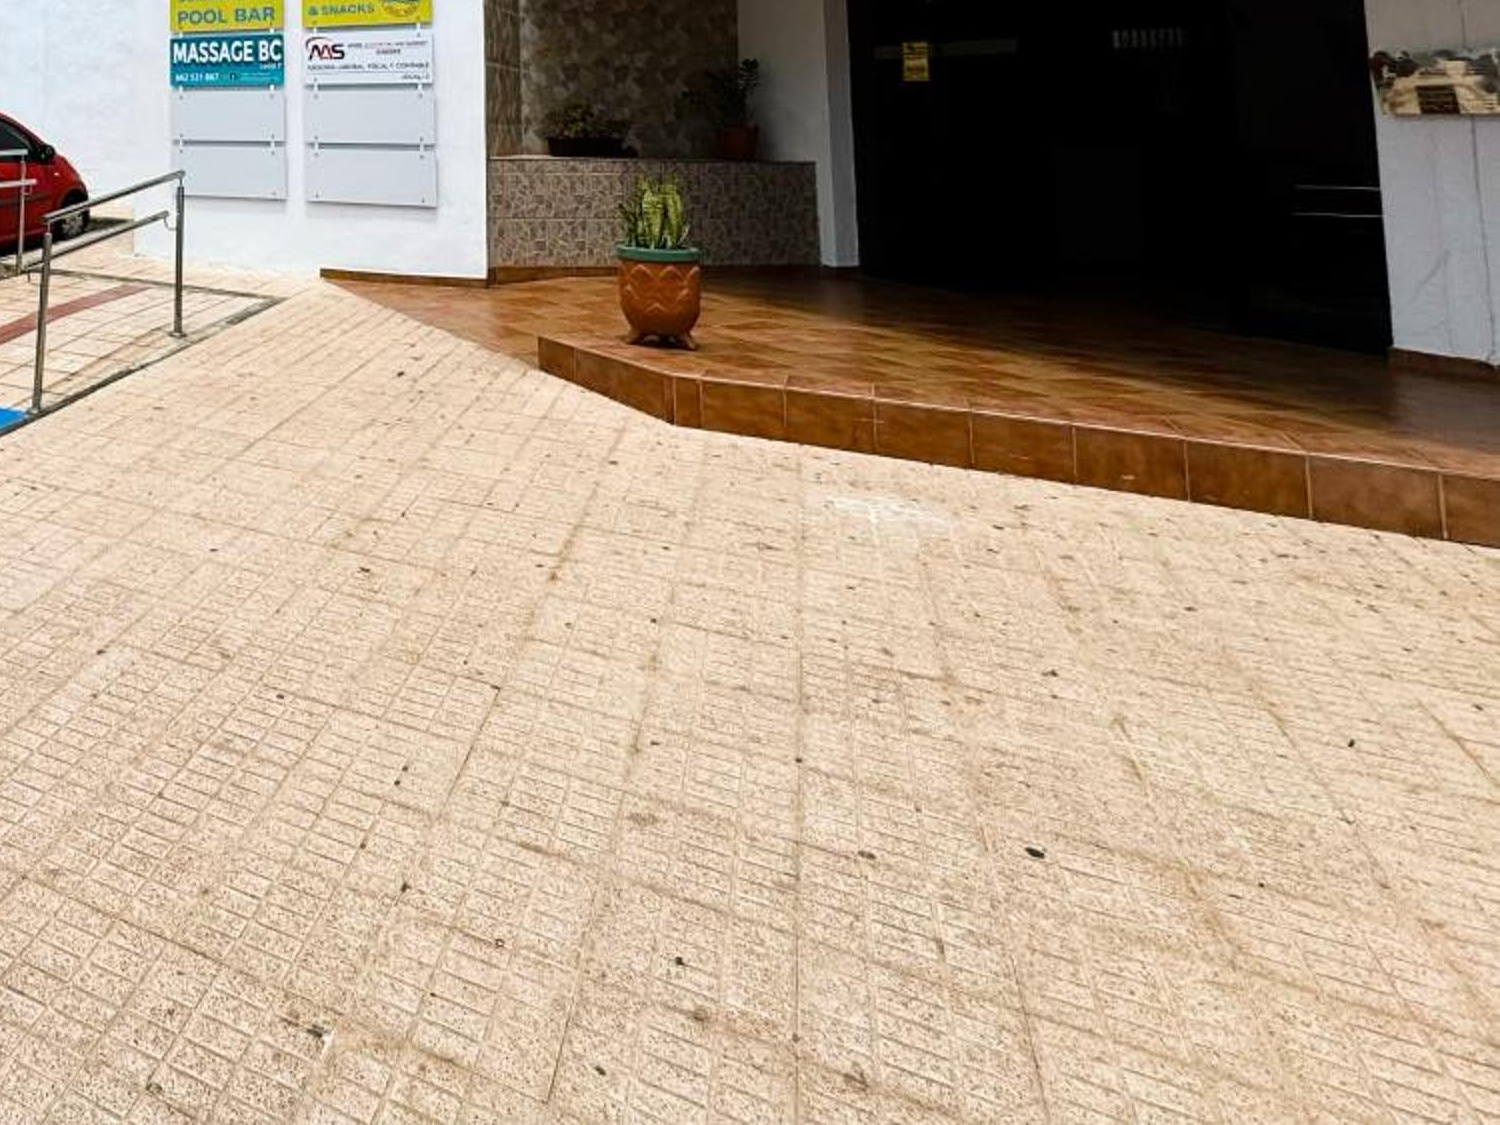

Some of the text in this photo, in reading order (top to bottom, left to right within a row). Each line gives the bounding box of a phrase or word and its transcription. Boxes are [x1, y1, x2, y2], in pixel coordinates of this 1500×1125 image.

[178, 6, 275, 26] POOL BAR
[321, 3, 375, 16] SNACKS
[173, 39, 282, 64] MASSAGE BC
